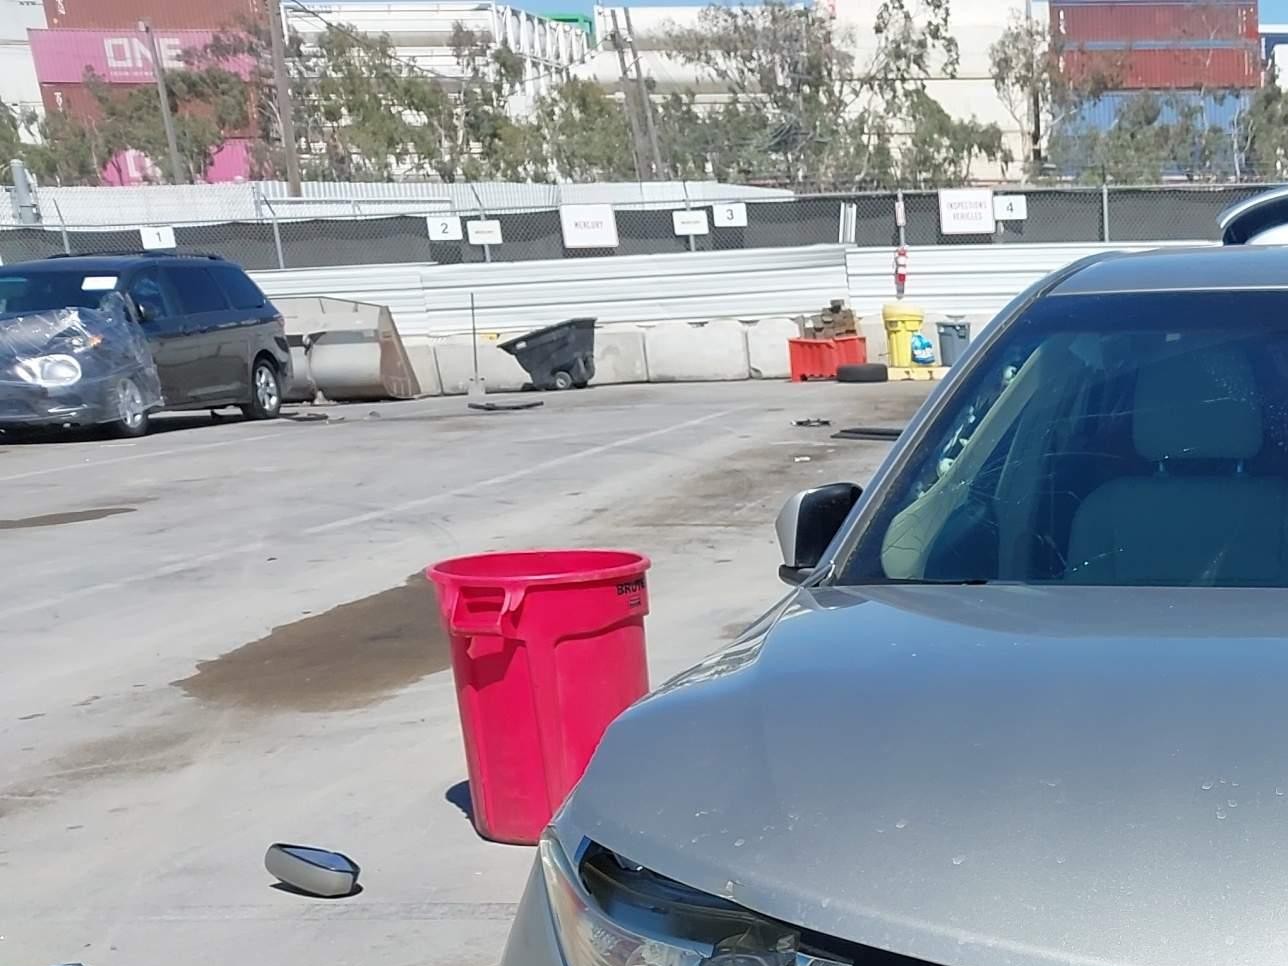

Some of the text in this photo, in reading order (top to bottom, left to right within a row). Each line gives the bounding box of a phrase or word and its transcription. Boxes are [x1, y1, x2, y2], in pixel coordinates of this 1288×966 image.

[103, 37, 185, 68] ONE
[1006, 202, 1014, 213] 4
[726, 209, 734, 221] 3
[440, 222, 449, 234] 2
[155, 231, 162, 243] 1
